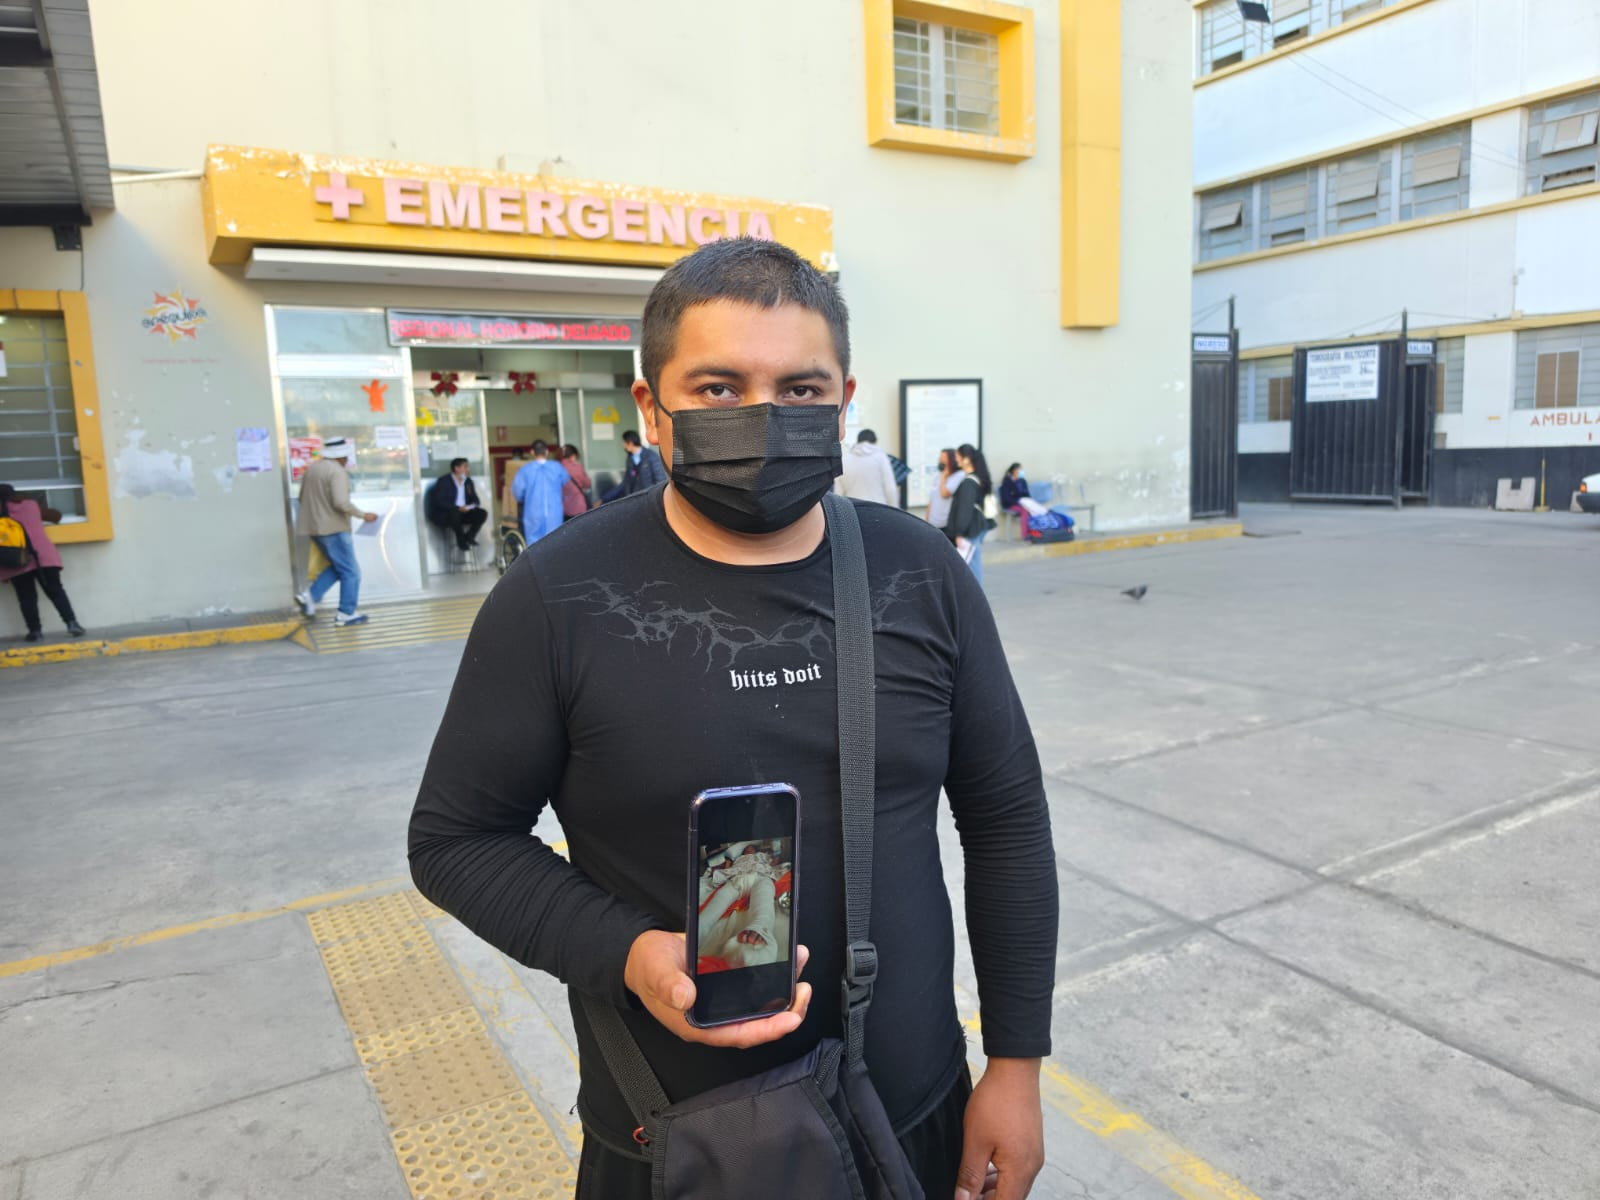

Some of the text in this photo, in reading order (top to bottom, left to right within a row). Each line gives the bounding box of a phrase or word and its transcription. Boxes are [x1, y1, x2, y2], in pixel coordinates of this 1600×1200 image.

[384, 177, 775, 247] EMERGENCIA
[389, 319, 631, 341] REGIONAL HONORIO DELGADO
[782, 663, 822, 684] doit
